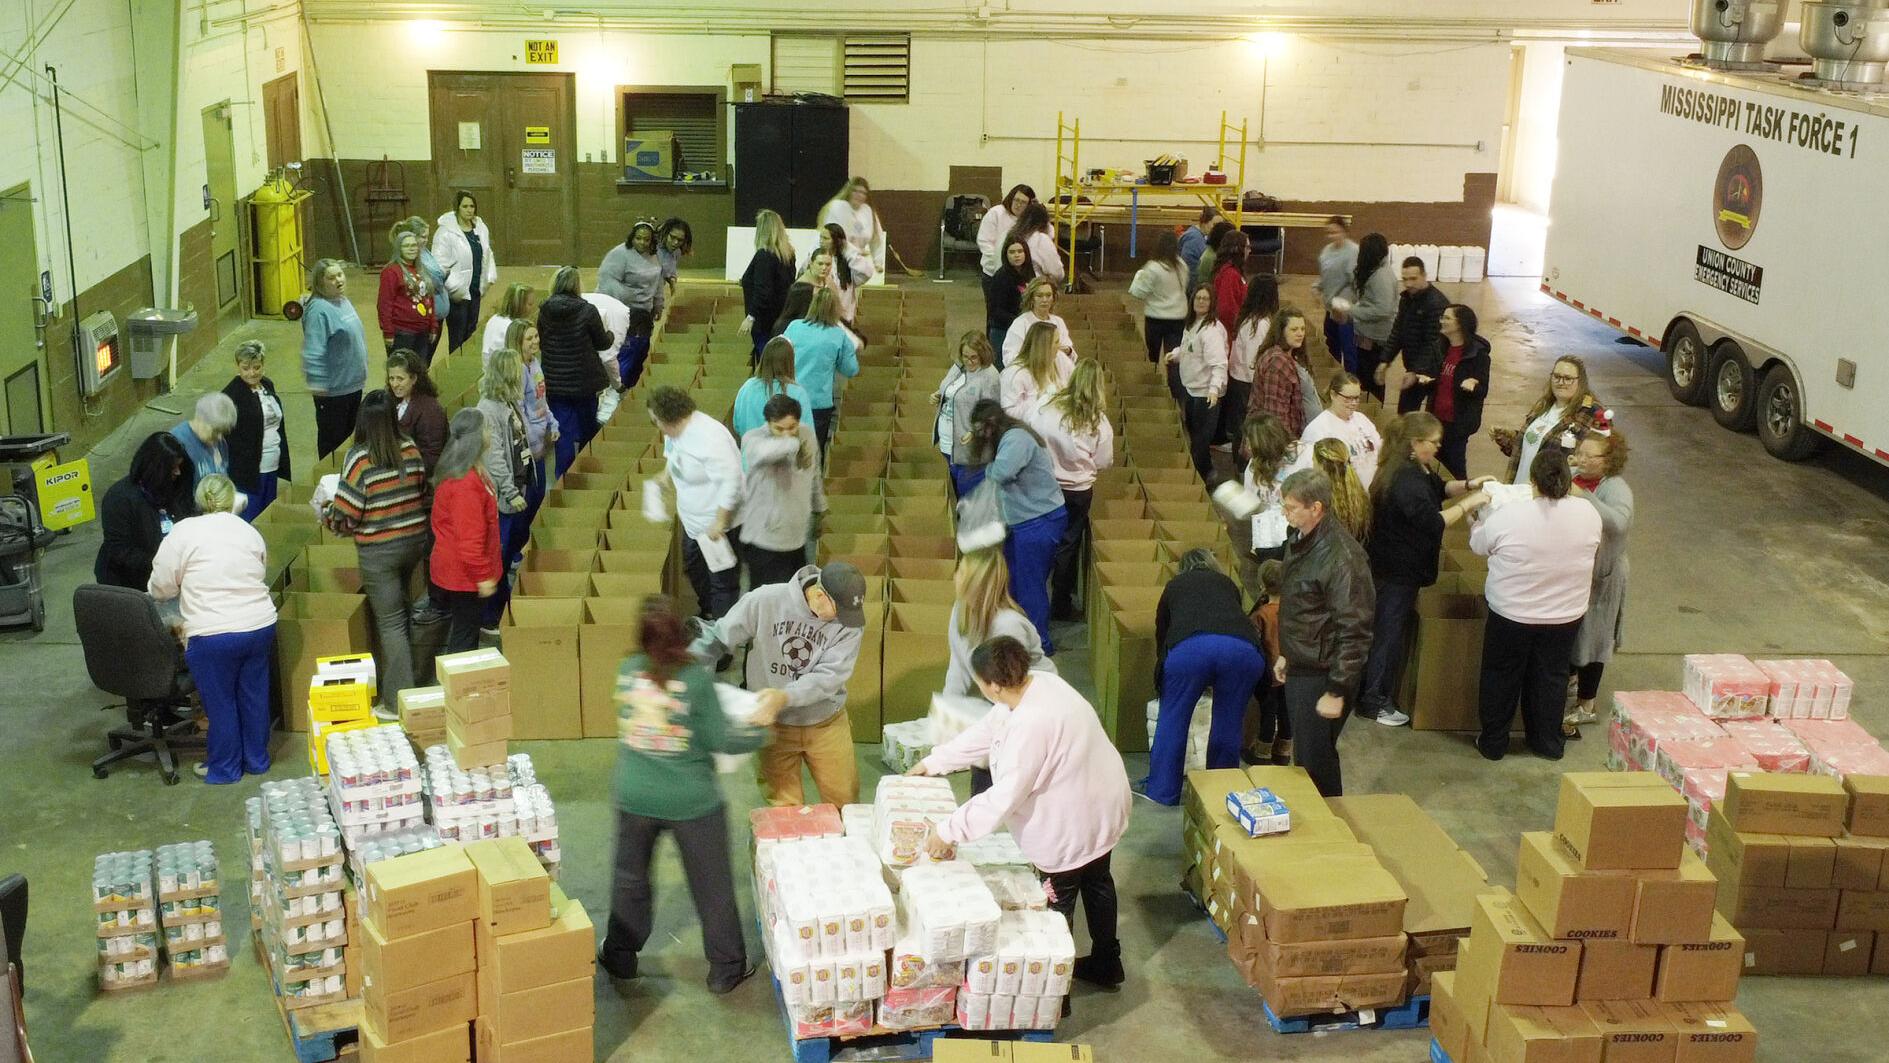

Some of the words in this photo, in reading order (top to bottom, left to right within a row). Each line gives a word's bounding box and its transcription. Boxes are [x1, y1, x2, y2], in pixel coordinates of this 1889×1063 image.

[528, 42, 542, 51] NOT
[545, 42, 555, 51] AN
[530, 53, 553, 62] EXIT
[1660, 84, 1741, 131] MISSISSIPPI
[1745, 102, 1786, 142] TASK
[1787, 112, 1845, 156] FORCE
[1850, 124, 1859, 159] 1
[523, 151, 554, 159] NOTICE
[1702, 247, 1726, 271] UNION
[1725, 257, 1756, 282] COUNTY
[1695, 263, 1731, 292] EMERGENCY
[1729, 278, 1760, 304] SERVICES
[46, 471, 79, 486] KIPOR
[773, 620, 795, 637] NEW
[1567, 930, 1618, 938] COOKIES
[1515, 944, 1567, 954] COOKIES
[1682, 942, 1732, 951] COOKIES
[1612, 1033, 1665, 1043] COOKIES
[1690, 1033, 1743, 1043] COOKIES
